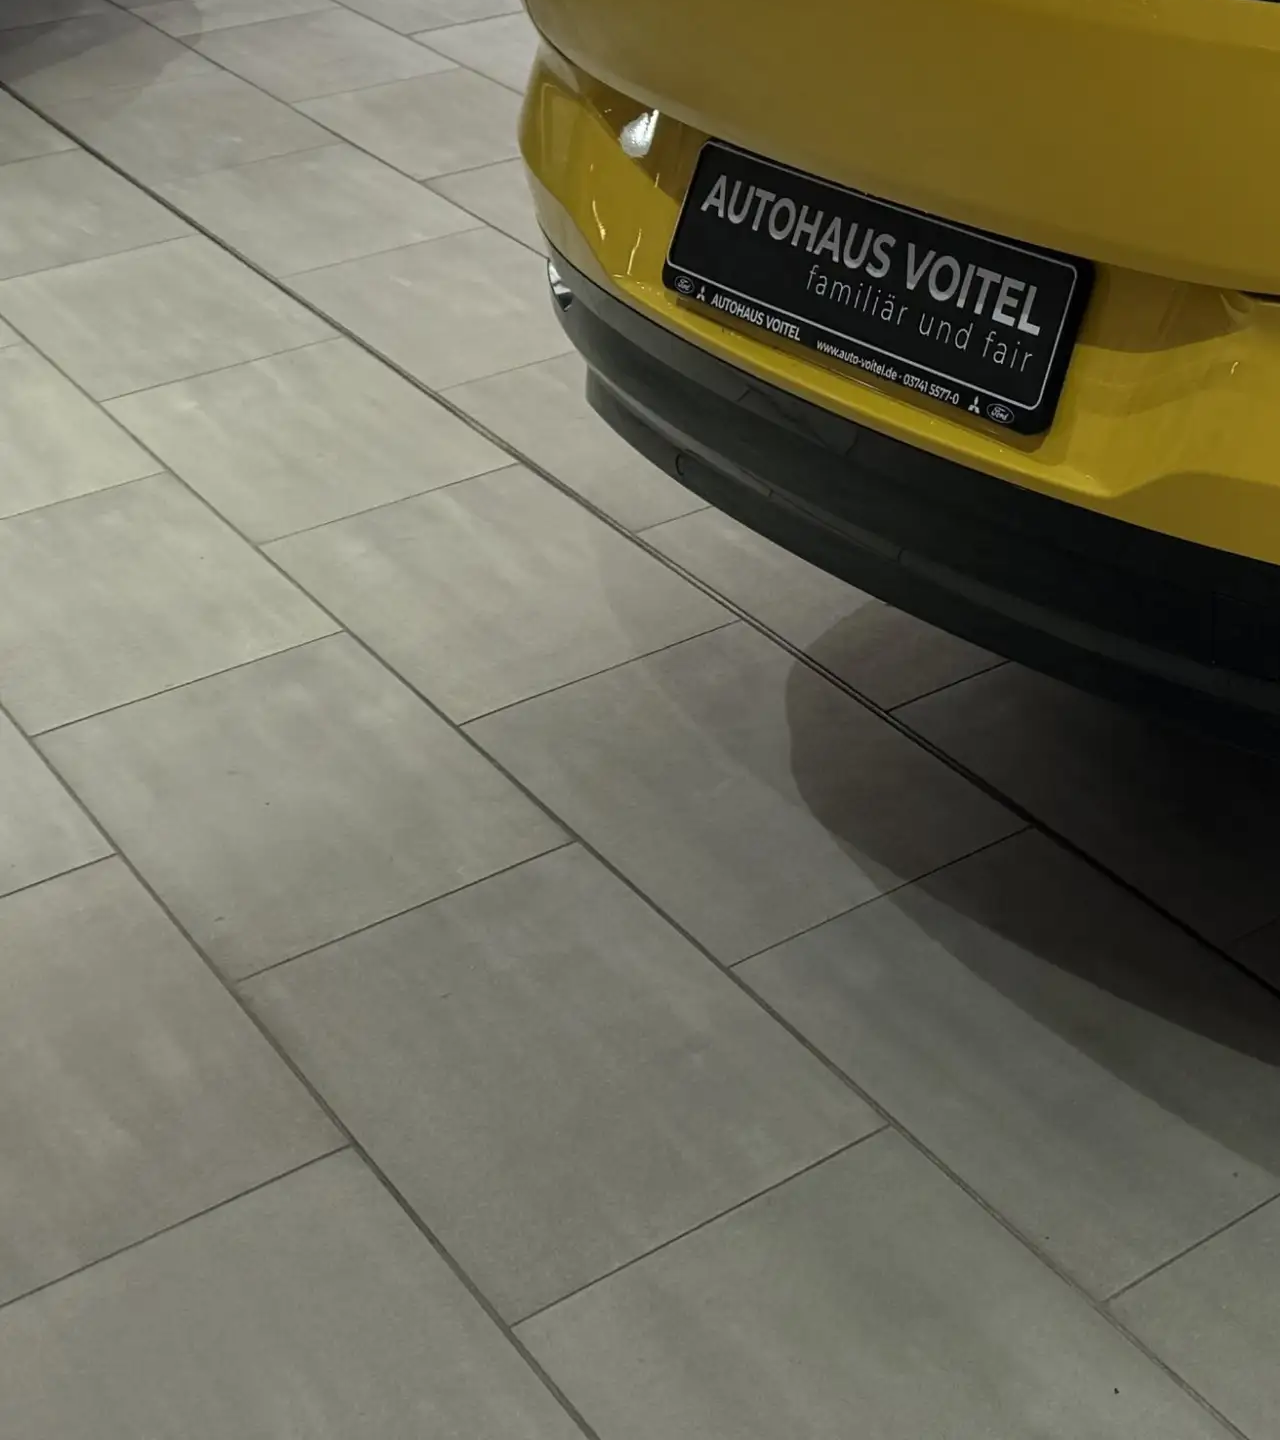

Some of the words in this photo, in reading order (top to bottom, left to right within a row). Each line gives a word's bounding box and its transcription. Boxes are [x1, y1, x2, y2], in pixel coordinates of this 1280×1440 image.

[700, 173, 897, 280] AUTOHAUS
[905, 242, 1043, 337] VOITEL
[710, 293, 765, 327] AUTOHAUS
[766, 313, 801, 341] VOITEL
[805, 264, 909, 328] familiär
[918, 308, 970, 352] und
[982, 330, 1033, 373] fair
[816, 339, 897, 381] www.auto-voitel.de
[903, 373, 929, 393] 03741
[928, 383, 960, 405] 5577-0
